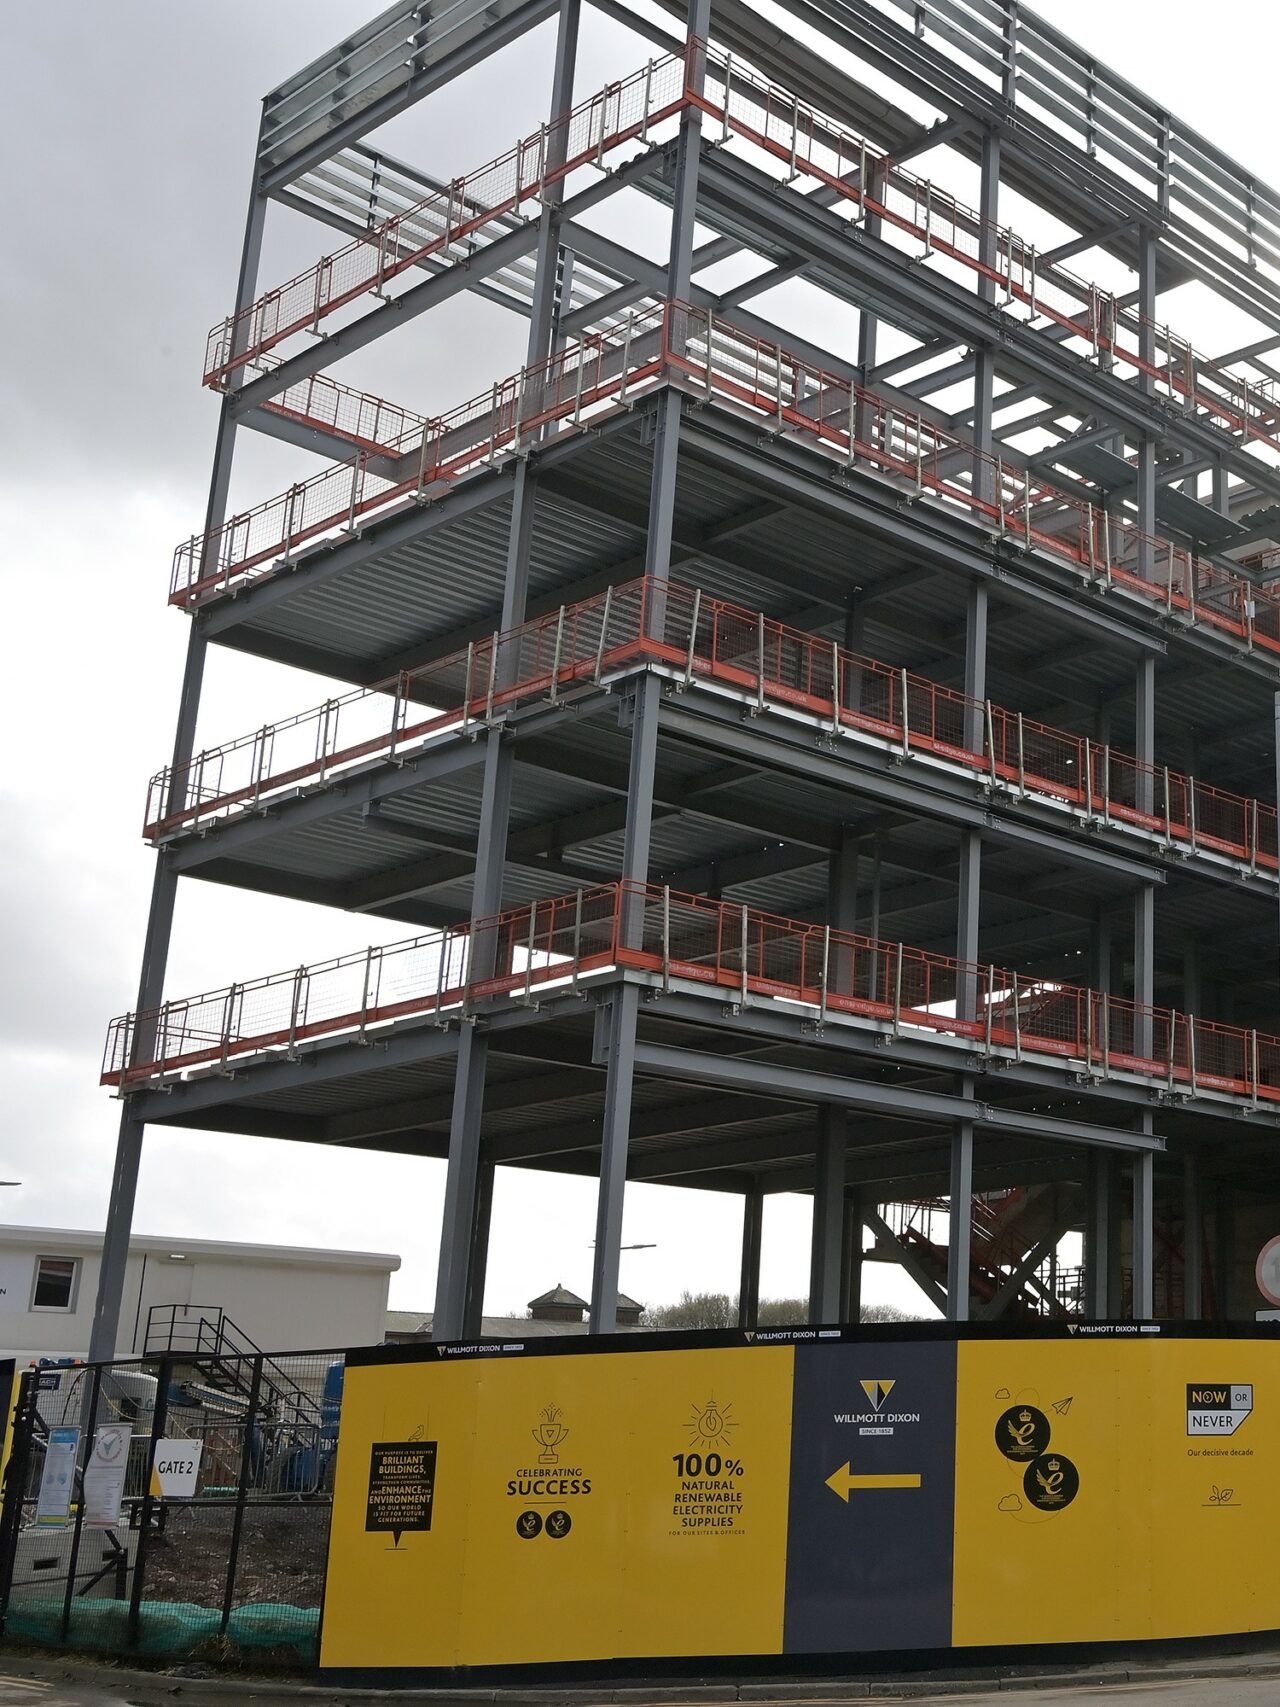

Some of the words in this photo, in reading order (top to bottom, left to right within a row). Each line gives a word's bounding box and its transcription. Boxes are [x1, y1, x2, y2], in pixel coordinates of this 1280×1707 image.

[1079, 1325, 1115, 1333] WILLMOTT
[1115, 1325, 1138, 1333] DIXON
[756, 1331, 792, 1340] WILLMOTT
[446, 1345, 478, 1354] WILLMOTT
[478, 1344, 501, 1352] DIXON
[1192, 1391, 1227, 1403] NOW
[1234, 1393, 1248, 1402] OR
[833, 1413, 886, 1423] WILLMOTT
[887, 1413, 920, 1423] DIXON
[1192, 1415, 1233, 1427] NEVER
[1187, 1449, 1201, 1457] Our
[1230, 1448, 1254, 1456] decade
[382, 1455, 425, 1465] BRILLIANT
[672, 1453, 744, 1477] 100%
[158, 1461, 186, 1474] GATE
[186, 1461, 194, 1474] 2
[379, 1464, 427, 1475] BUILDINGS,
[516, 1468, 583, 1477] CELEBRATING
[381, 1485, 422, 1495] ENHANCE
[506, 1479, 592, 1496] SUCCESS
[681, 1480, 735, 1491] NATURAL
[369, 1494, 432, 1504] ENVIRONMENT
[674, 1492, 742, 1503] RENEWABLE
[672, 1504, 744, 1515] ELECTRICITY
[681, 1517, 734, 1527] SUPPLIES
